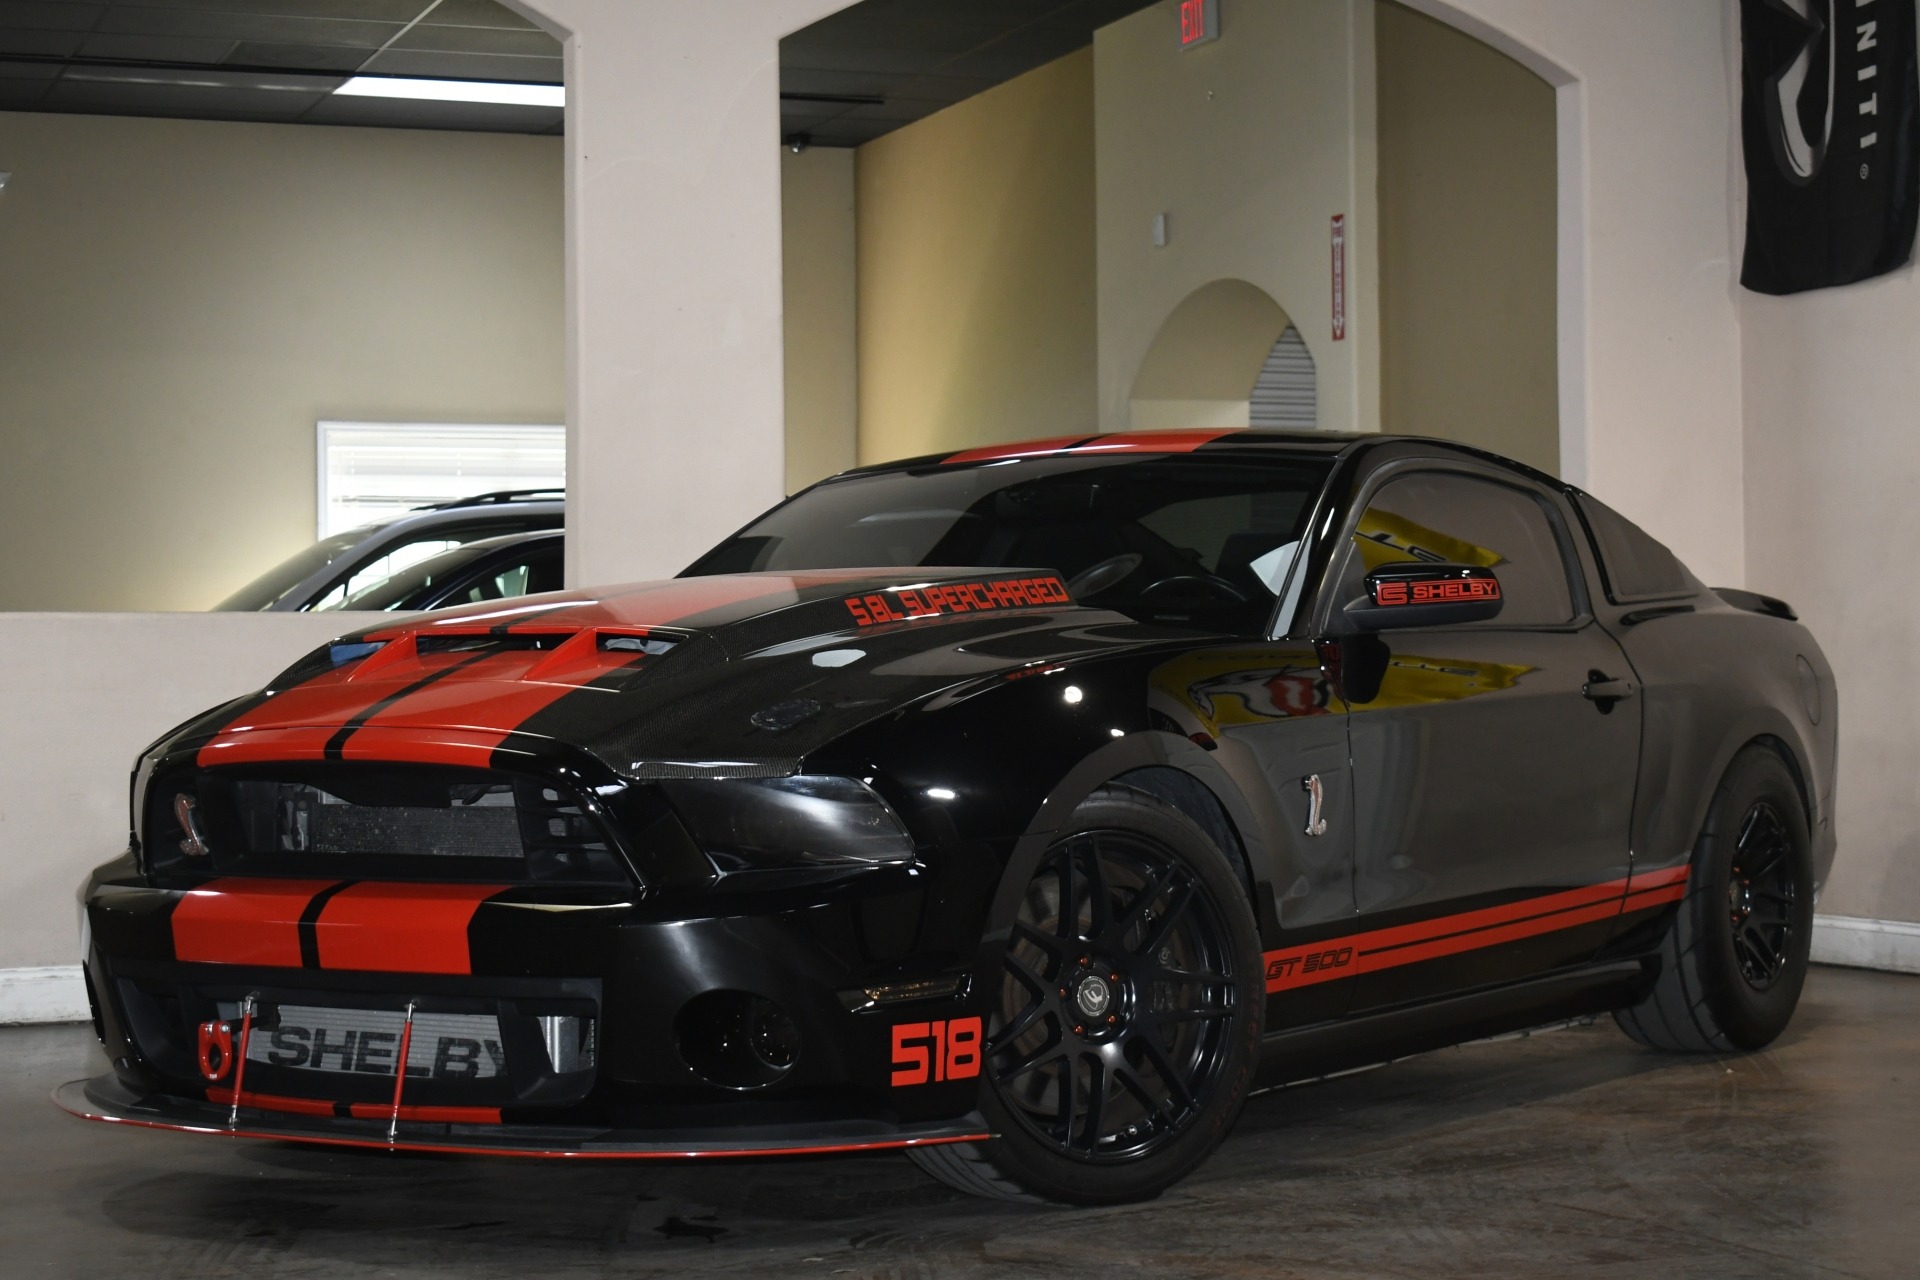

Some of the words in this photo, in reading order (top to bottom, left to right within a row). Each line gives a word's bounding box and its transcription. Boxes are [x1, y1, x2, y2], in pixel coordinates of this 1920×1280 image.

[1181, 0, 1204, 45] EXIT
[844, 594, 903, 626] 5.8L
[900, 577, 1070, 617] SUPERCHARGED
[1413, 583, 1495, 599] SHELBY
[1265, 956, 1303, 981] GT
[1302, 947, 1353, 974] 500
[891, 1016, 982, 1087] 518
